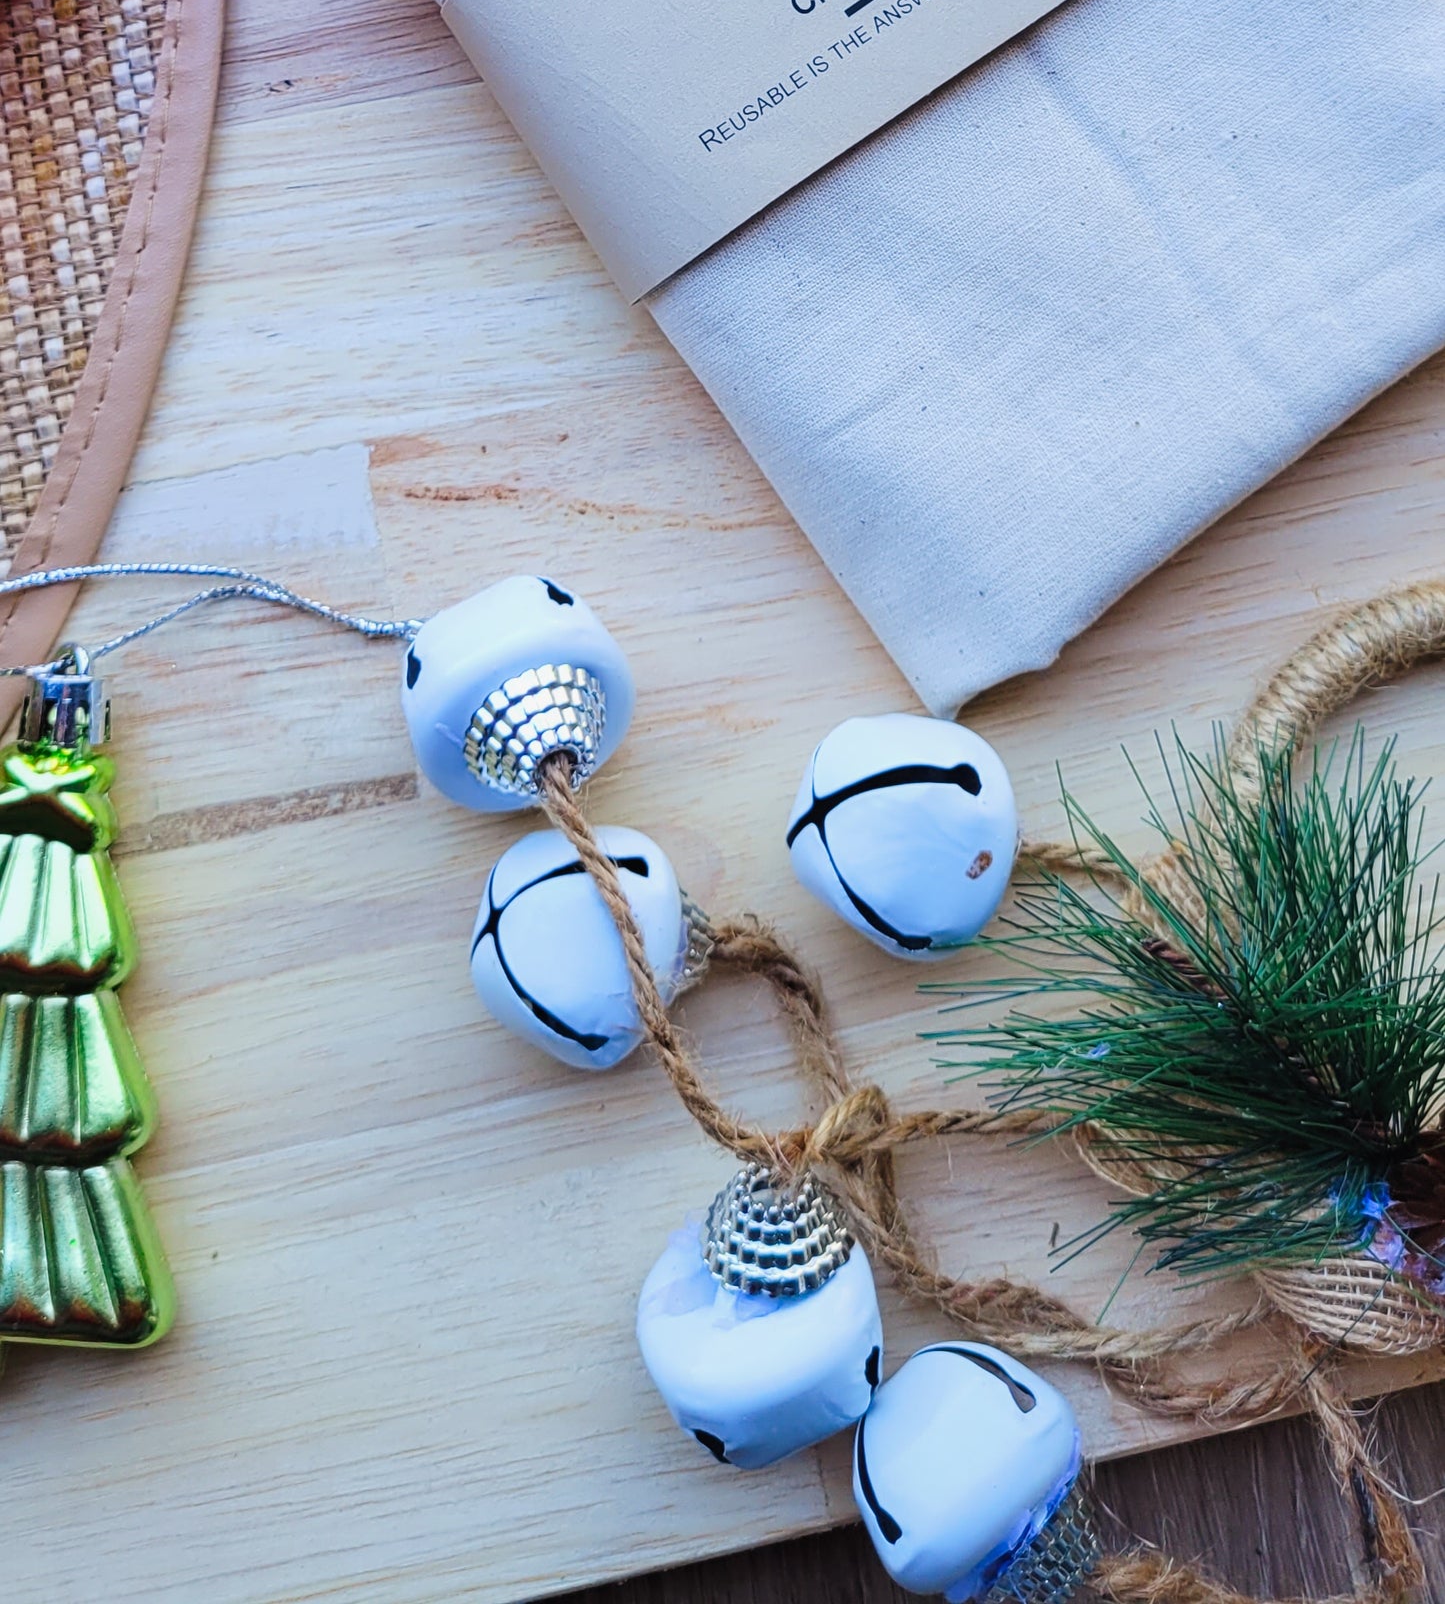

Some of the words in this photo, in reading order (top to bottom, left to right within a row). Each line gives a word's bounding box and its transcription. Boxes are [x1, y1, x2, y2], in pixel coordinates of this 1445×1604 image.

[698, 71, 808, 152] REUSABLE
[806, 56, 829, 79] IS
[827, 26, 873, 61] THE
